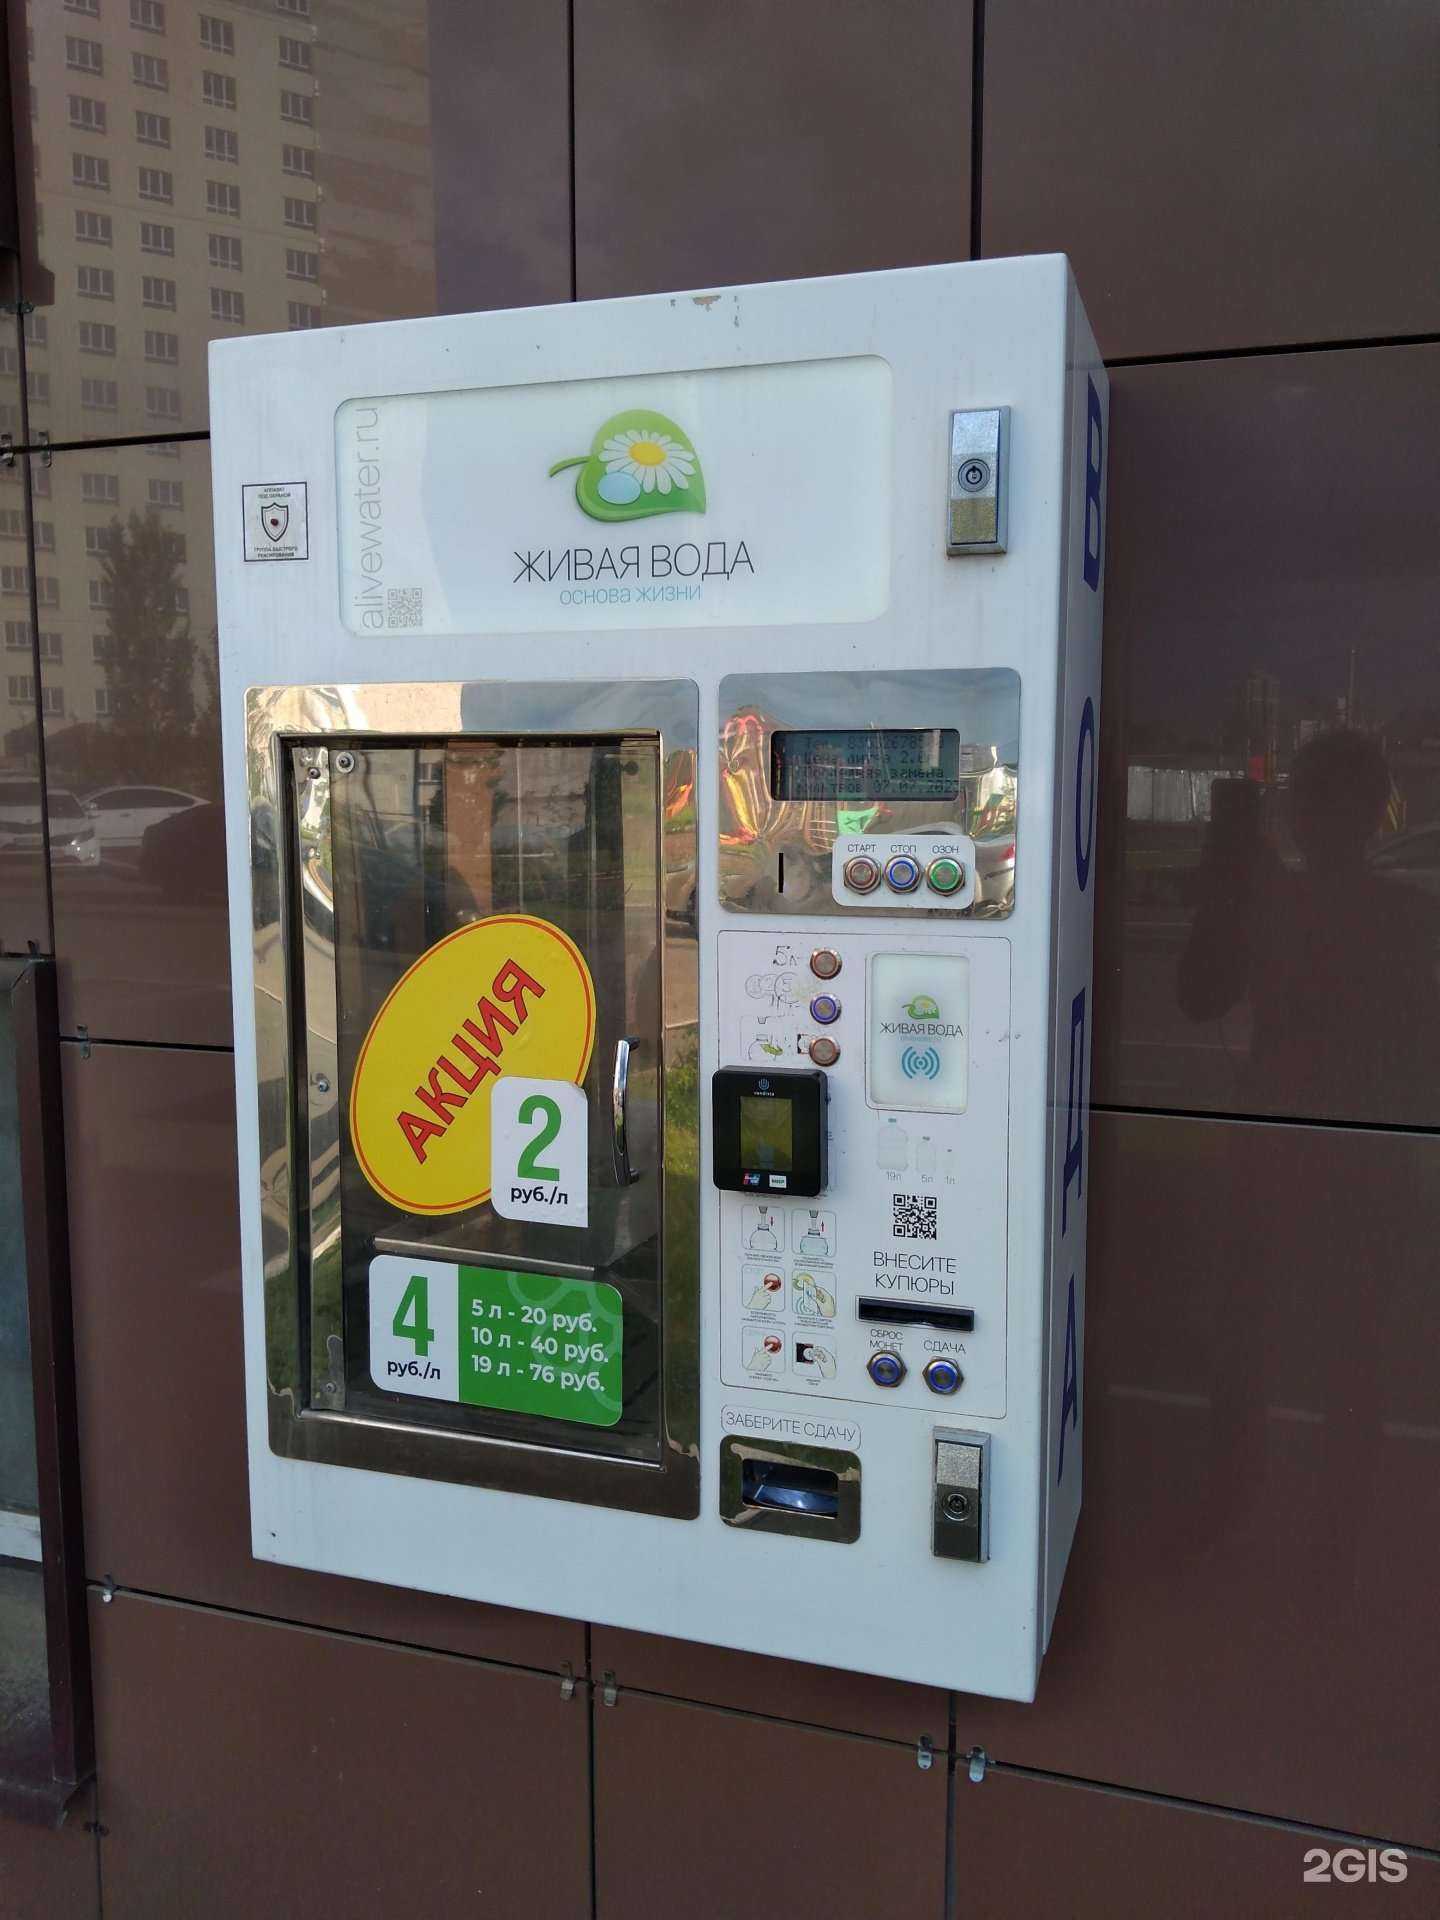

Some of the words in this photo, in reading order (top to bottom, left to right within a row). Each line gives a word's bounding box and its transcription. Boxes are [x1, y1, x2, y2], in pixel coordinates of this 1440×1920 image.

[353, 407, 384, 629] alivewater.ru
[513, 545, 640, 583] ЖИВАЯ
[651, 541, 755, 581] ВОДА
[848, 843, 877, 853] СТАРТ
[890, 844, 917, 854] СТОП
[932, 845, 959, 854] ОЗОН
[1057, 372, 1103, 1488] ВОДА
[880, 1022, 926, 1035] ЖИВАЯ
[928, 1023, 964, 1037] ВОДА
[397, 958, 546, 1165] АКЦИЯ
[517, 1094, 561, 1182] 2
[511, 1185, 568, 1205] руб./л
[873, 1251, 957, 1274] ВНЕСИТЕ
[875, 1273, 954, 1295] КУПЮРЫ
[392, 1275, 435, 1358] 4
[471, 1298, 483, 1317] 5
[488, 1304, 501, 1320] л
[521, 1305, 547, 1325] 20
[552, 1312, 598, 1334] руб.
[471, 1326, 493, 1346] 10
[497, 1333, 511, 1349] л
[530, 1336, 558, 1355] 40
[564, 1343, 609, 1364] руб.
[869, 1340, 904, 1351] МОНЕТ
[870, 1328, 904, 1340] СБРОС
[923, 1340, 967, 1354] СДАЧА
[387, 1359, 441, 1380] руб./л
[471, 1354, 492, 1374] 19
[497, 1361, 510, 1377] л
[529, 1363, 555, 1383] 76
[560, 1370, 606, 1392] руб.
[726, 1411, 800, 1435] ЗАБЕРИТЕ
[803, 1422, 856, 1442] СДАЧУ
